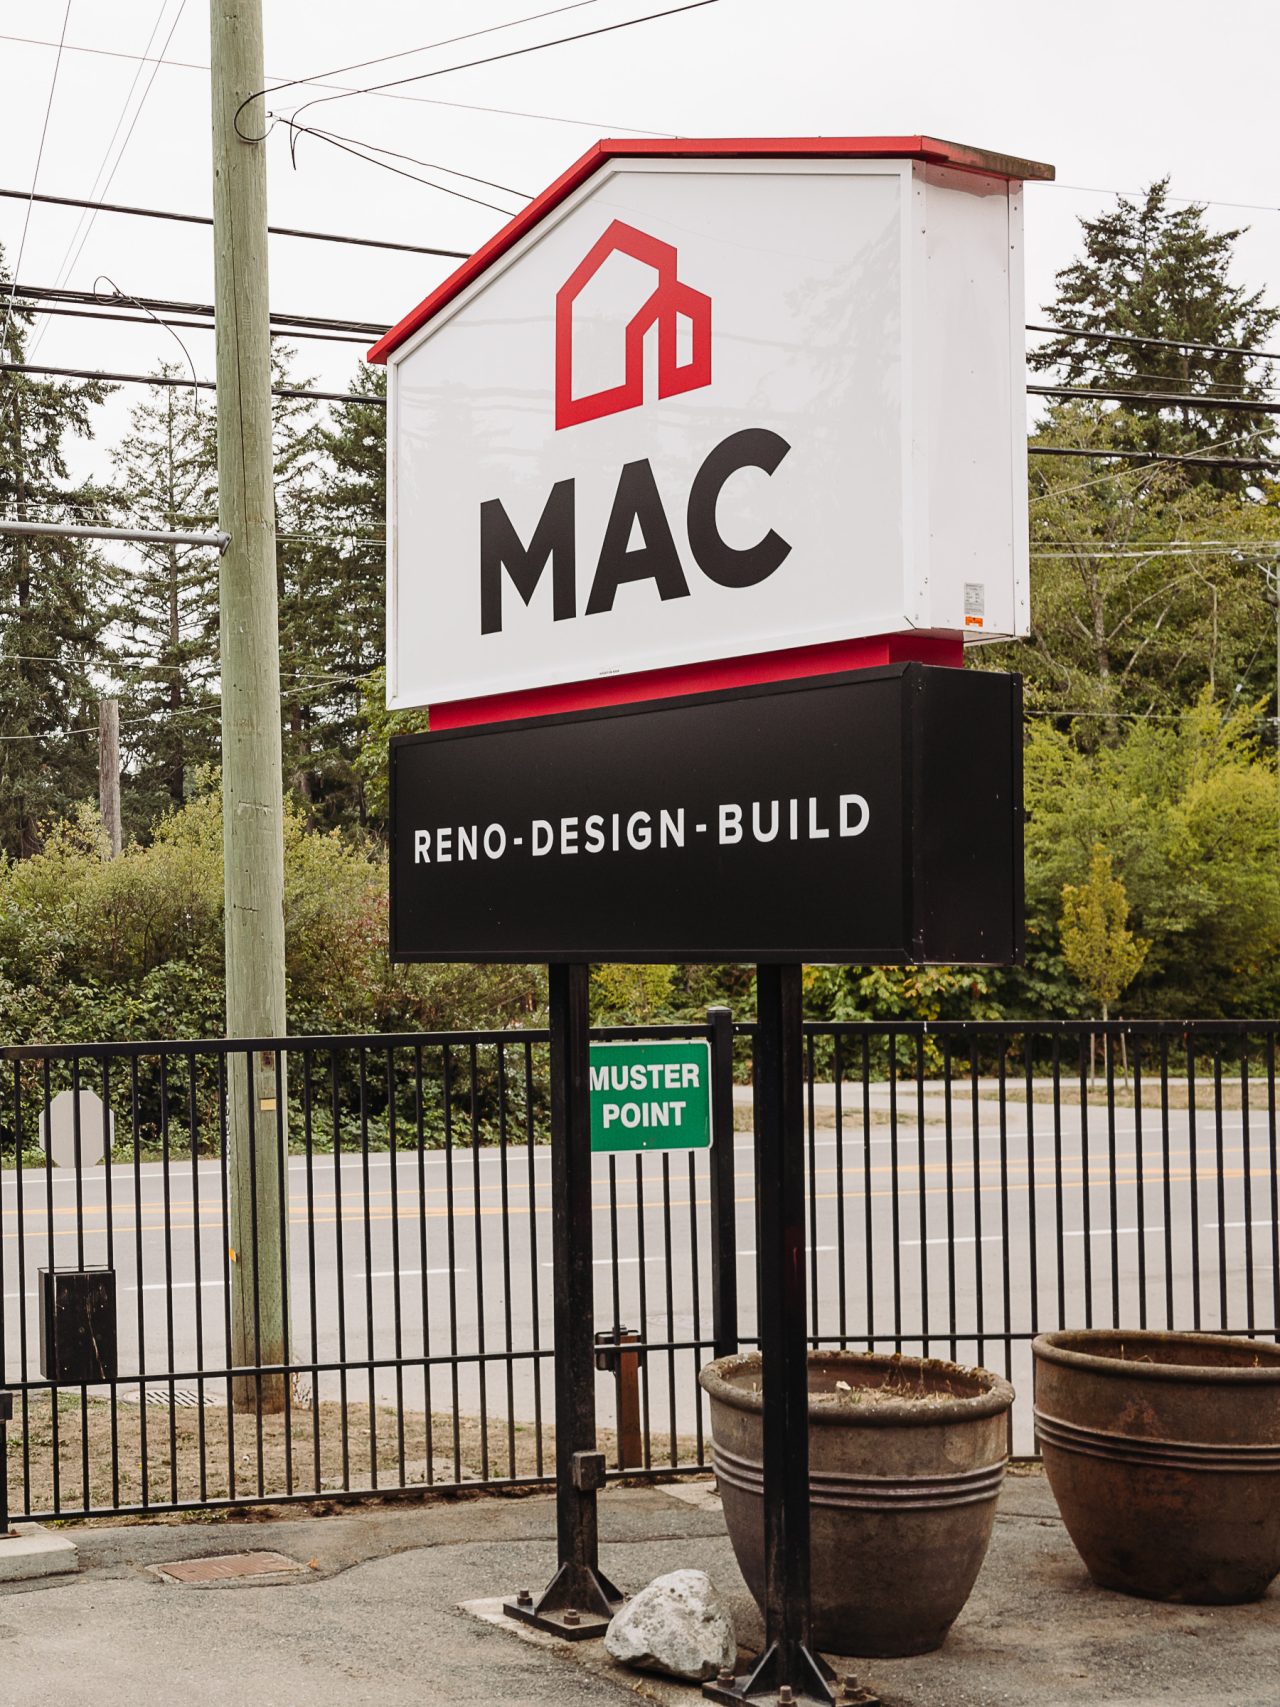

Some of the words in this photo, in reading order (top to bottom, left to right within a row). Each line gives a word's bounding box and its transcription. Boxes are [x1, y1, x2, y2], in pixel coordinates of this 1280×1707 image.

[481, 428, 792, 635] MAC
[590, 1063, 700, 1091] MUSTER
[602, 1101, 687, 1129] POINT
